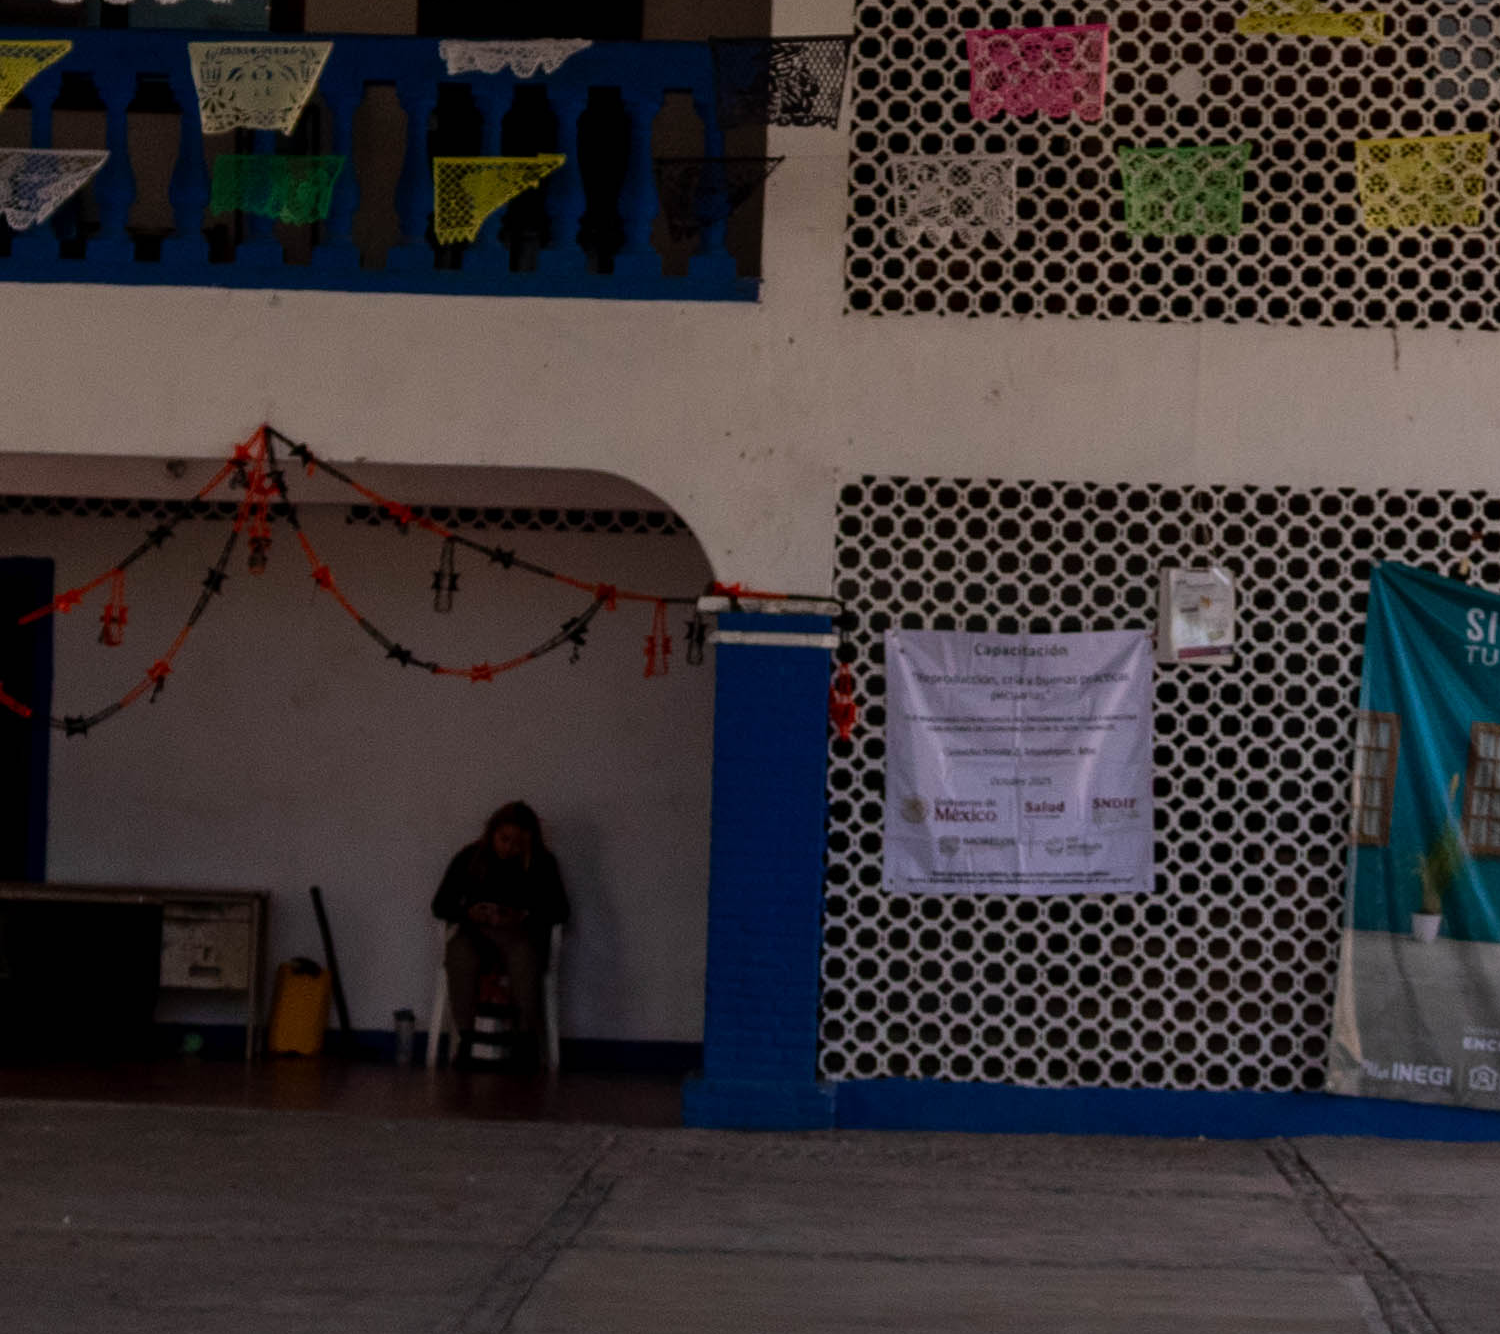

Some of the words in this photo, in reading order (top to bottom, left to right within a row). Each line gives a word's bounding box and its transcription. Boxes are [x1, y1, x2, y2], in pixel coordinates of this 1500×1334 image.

[1465, 607, 1498, 646] SI
[974, 641, 1069, 659] Capacitación
[1464, 644, 1500, 667] TU
[934, 805, 998, 822] México
[1024, 800, 1066, 813] Salud
[1391, 1061, 1454, 1087] INEGI
